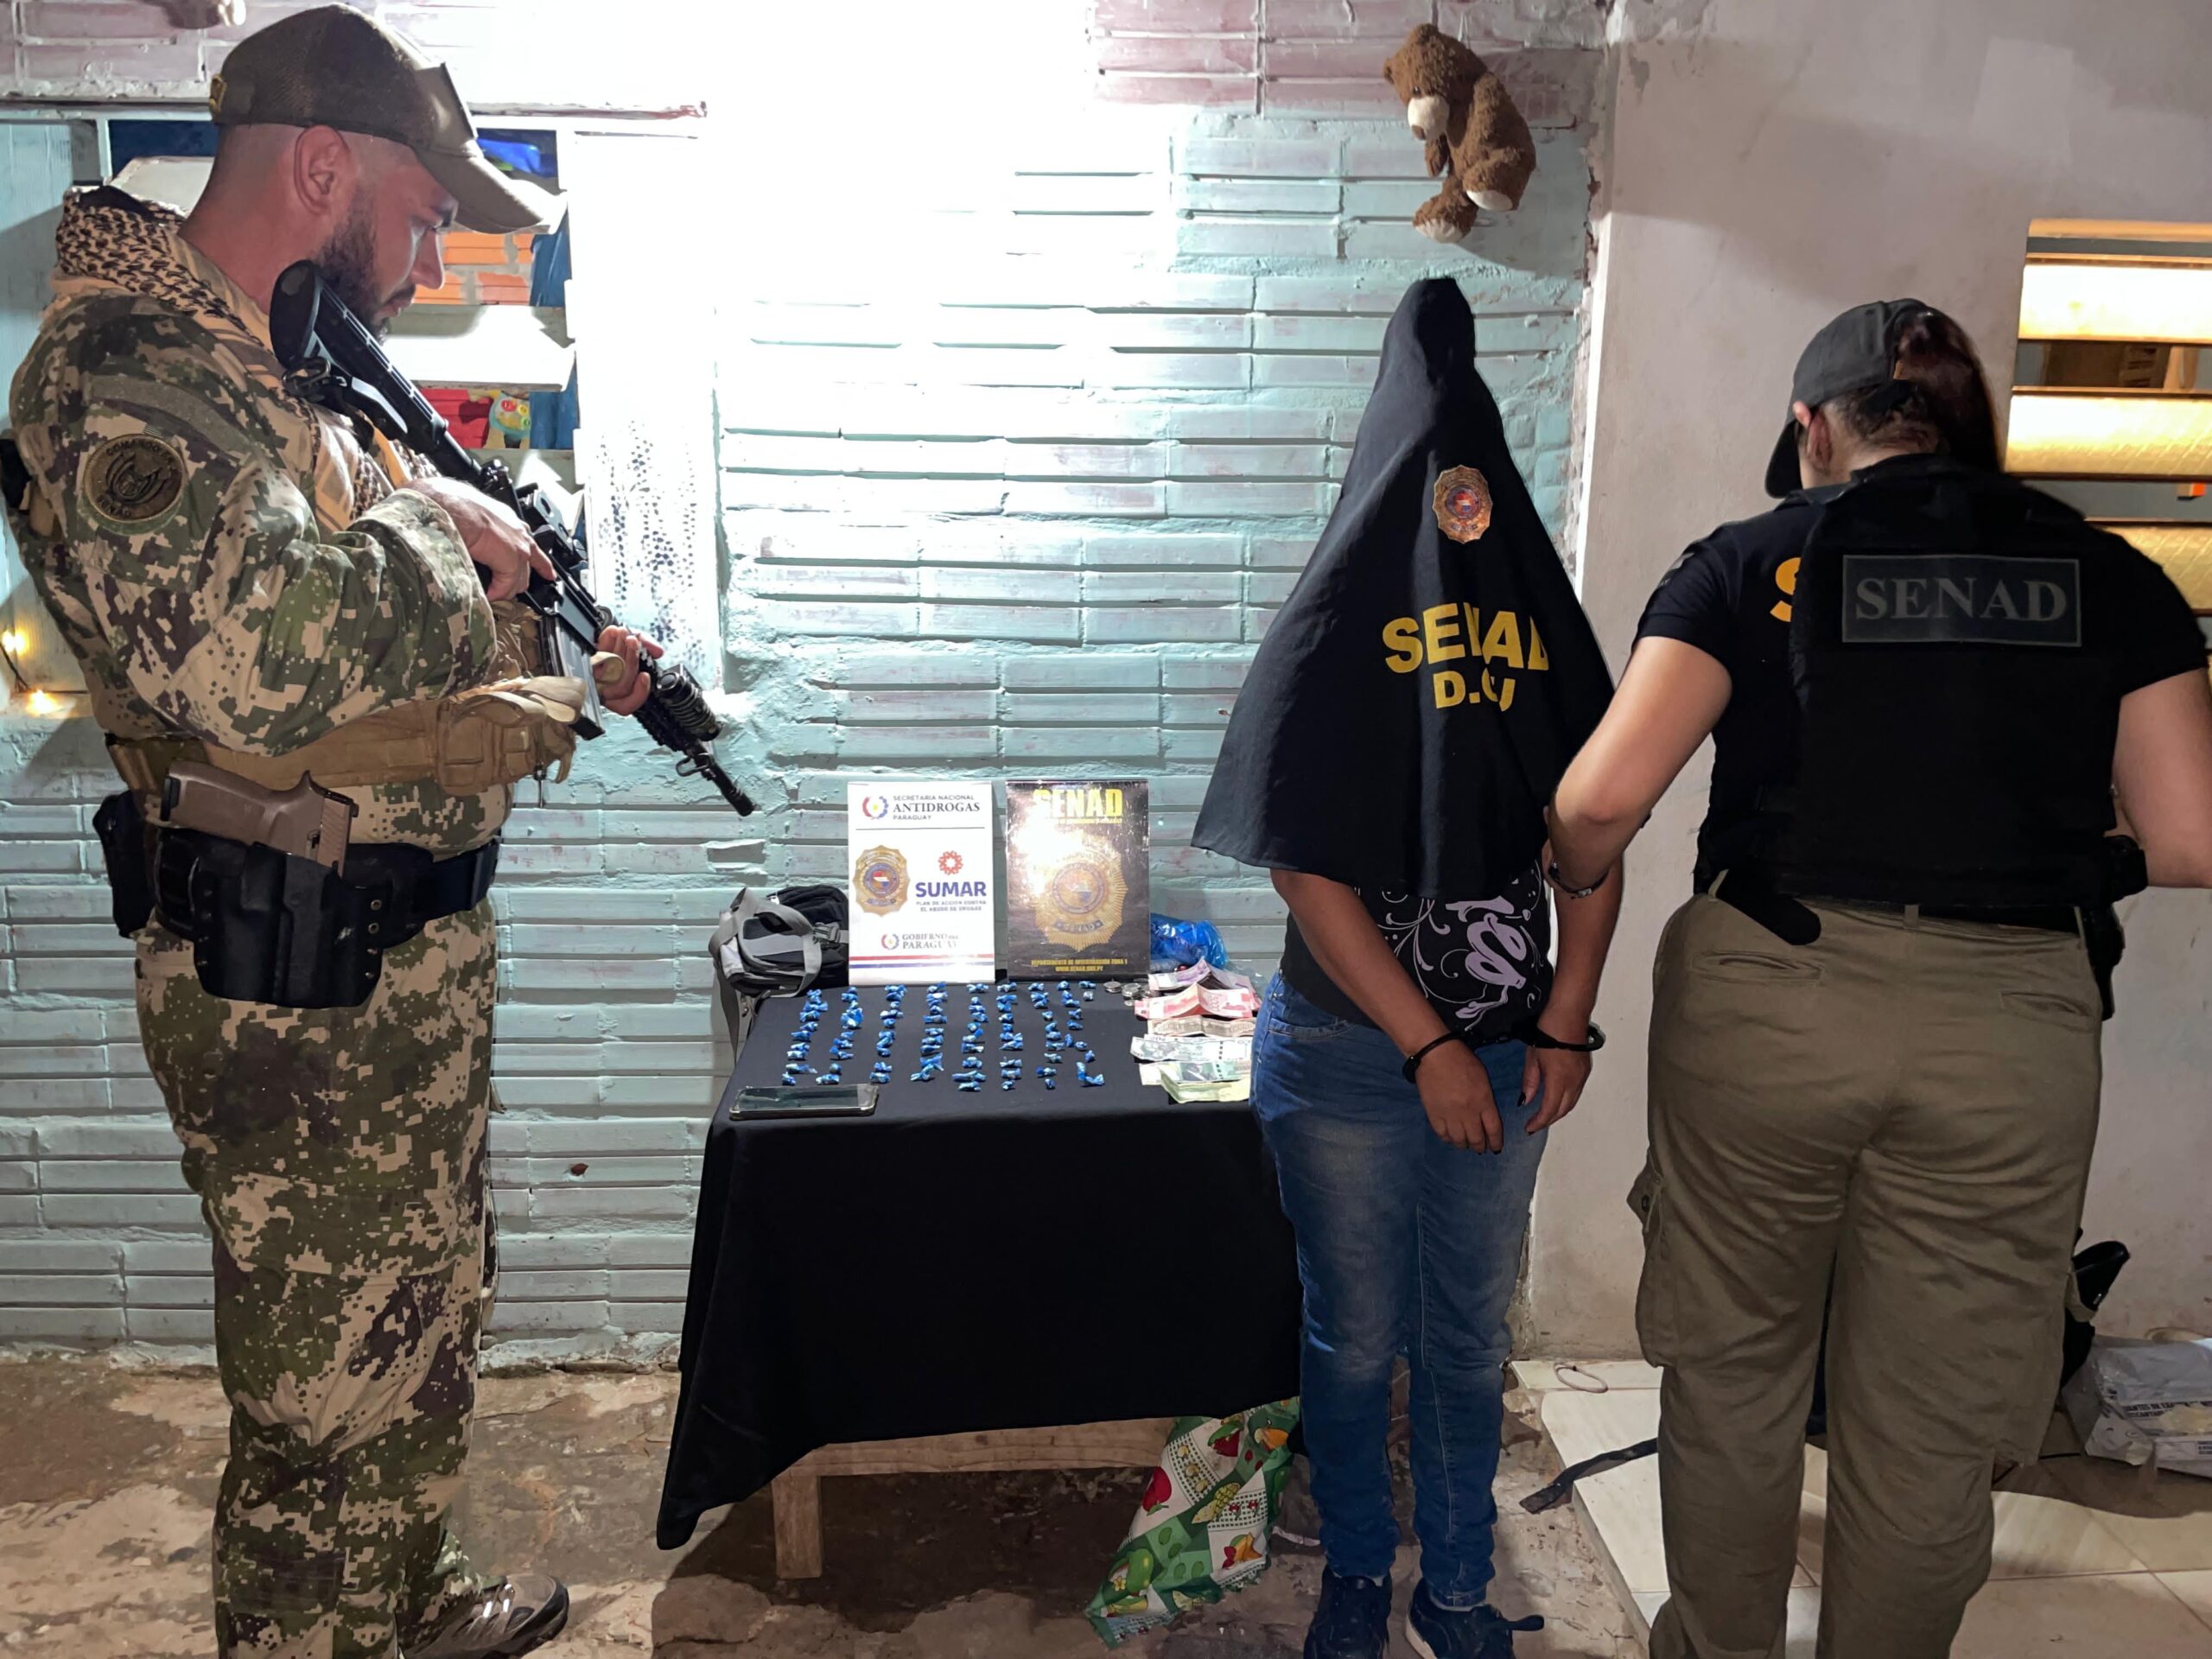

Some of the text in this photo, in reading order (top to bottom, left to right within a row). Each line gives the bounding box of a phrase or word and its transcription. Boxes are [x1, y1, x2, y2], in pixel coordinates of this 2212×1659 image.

[1855, 576, 2068, 622] SENAD
[893, 802, 981, 813] ANTIDROGAS
[1033, 788, 1122, 817] SENAD
[915, 881, 988, 898] SUMAR
